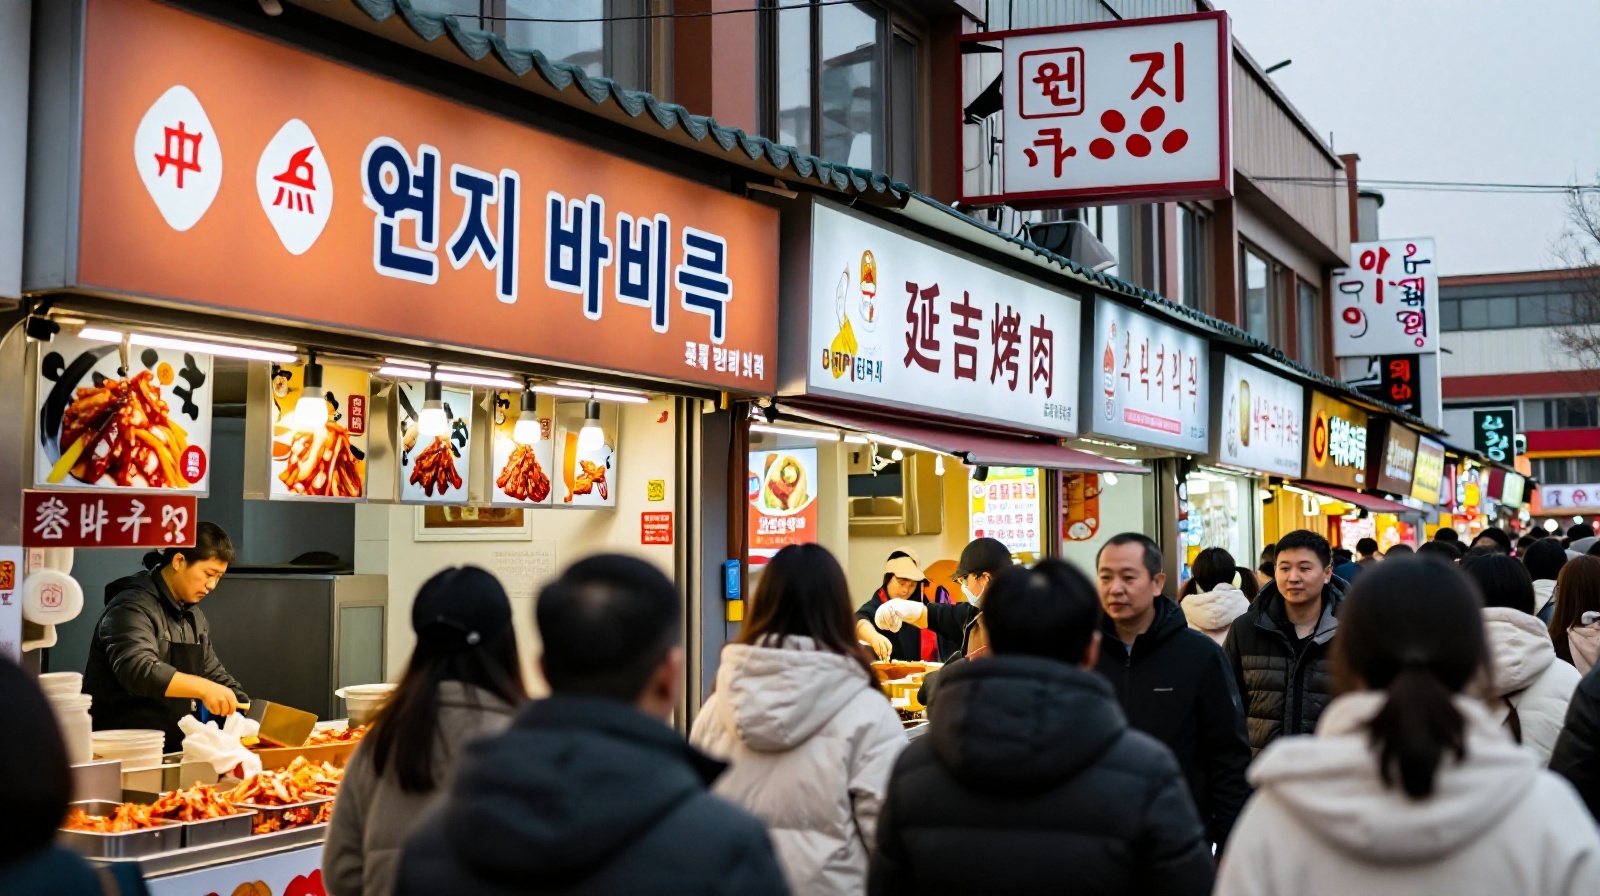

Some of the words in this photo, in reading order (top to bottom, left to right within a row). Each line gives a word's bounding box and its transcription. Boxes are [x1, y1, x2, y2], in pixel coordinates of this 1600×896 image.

[1129, 42, 1184, 103] 지
[362, 137, 521, 303] 연지
[903, 278, 1054, 399] 延吉烤肉
